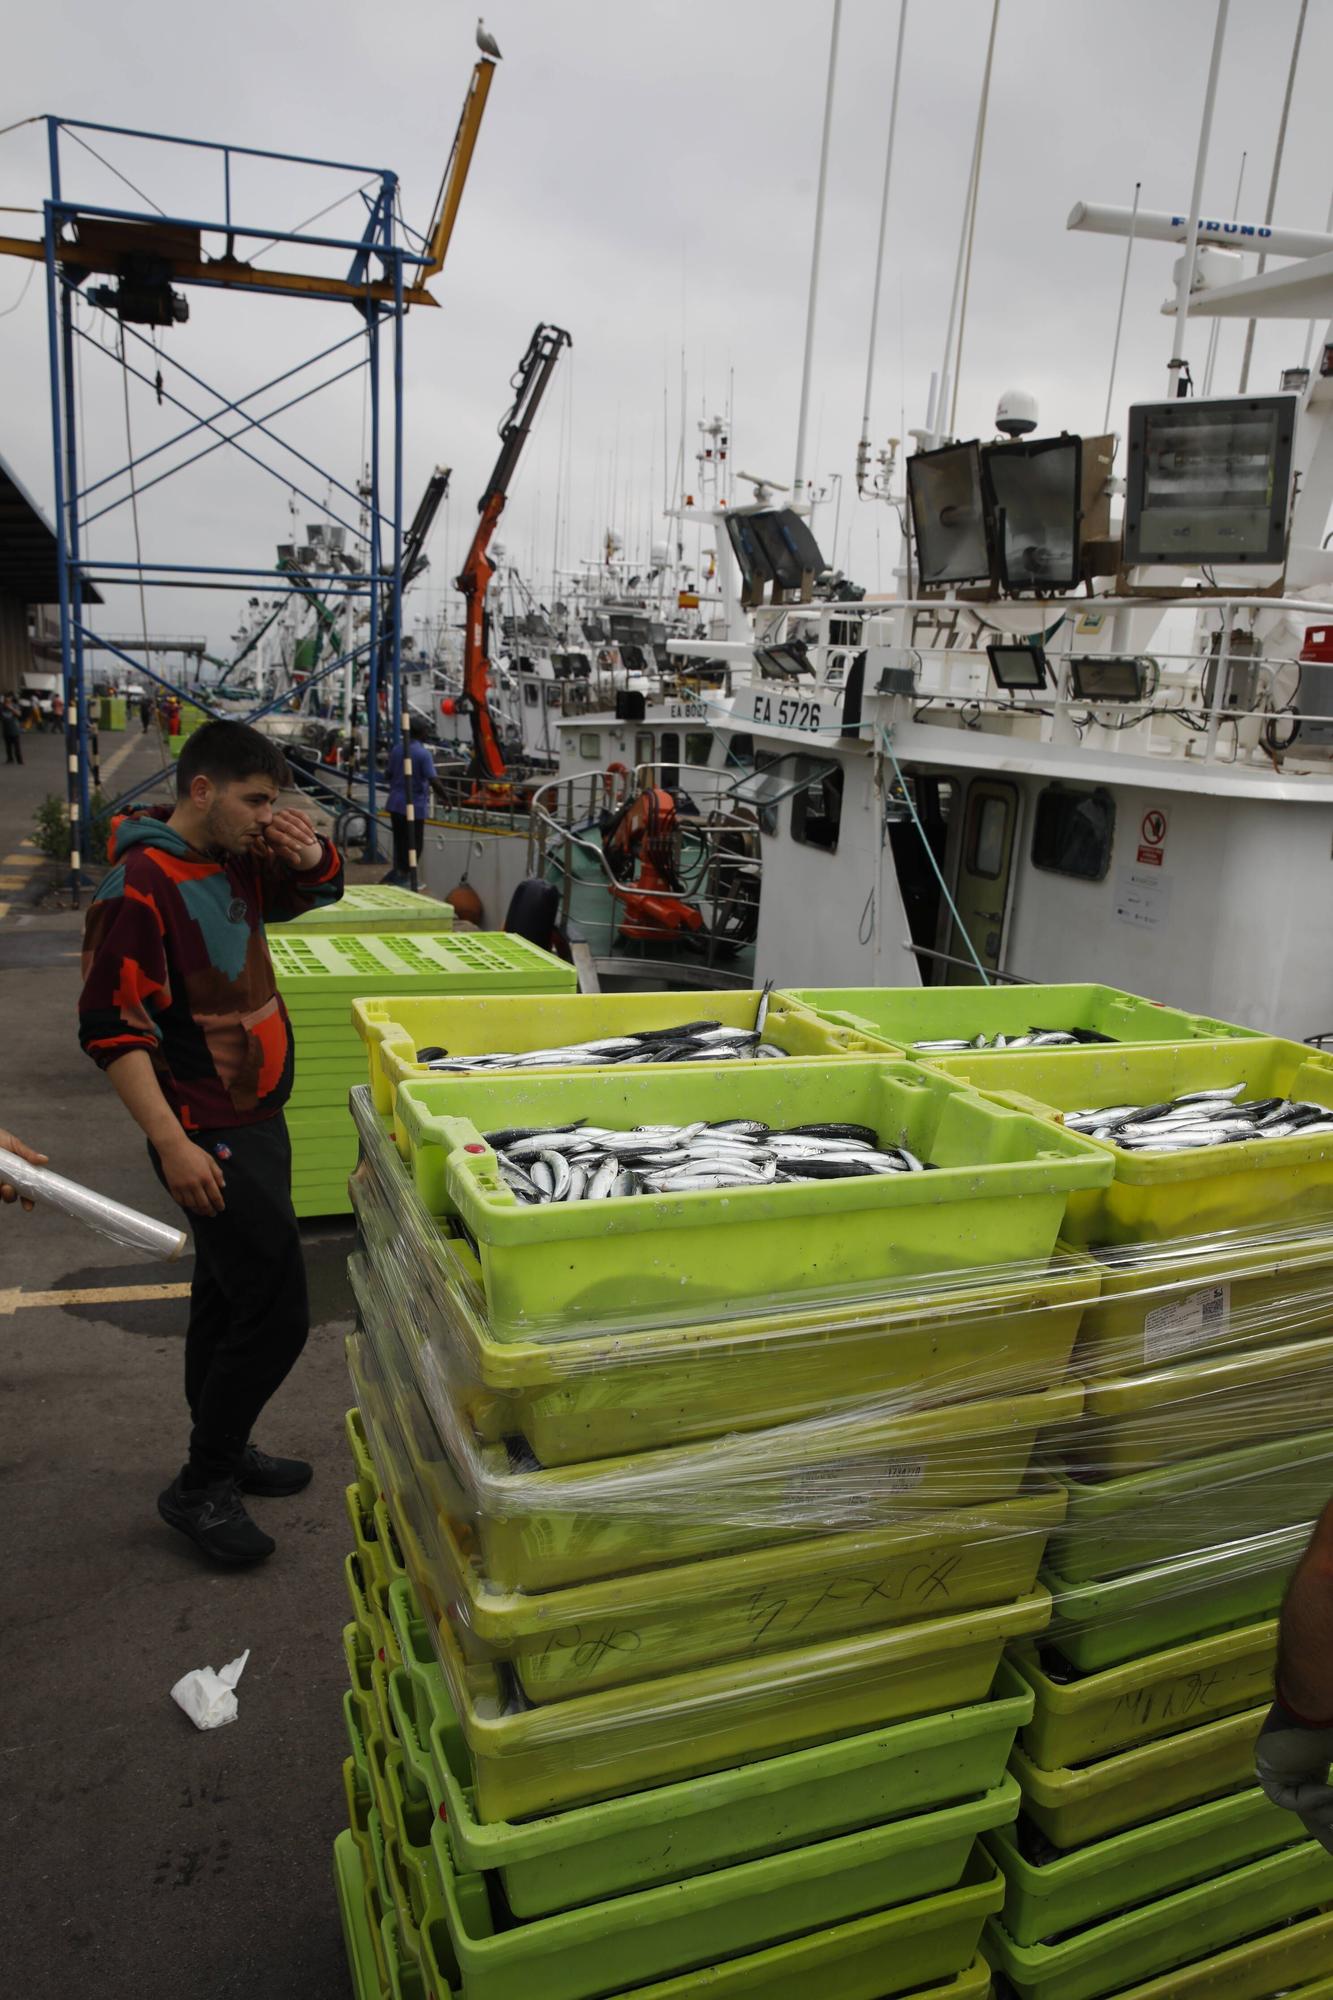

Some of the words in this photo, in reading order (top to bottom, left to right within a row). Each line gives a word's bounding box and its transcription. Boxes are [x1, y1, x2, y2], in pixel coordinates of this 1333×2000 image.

[671, 704, 682, 718] EA
[753, 696, 771, 723] EA
[778, 700, 821, 733] 5726
